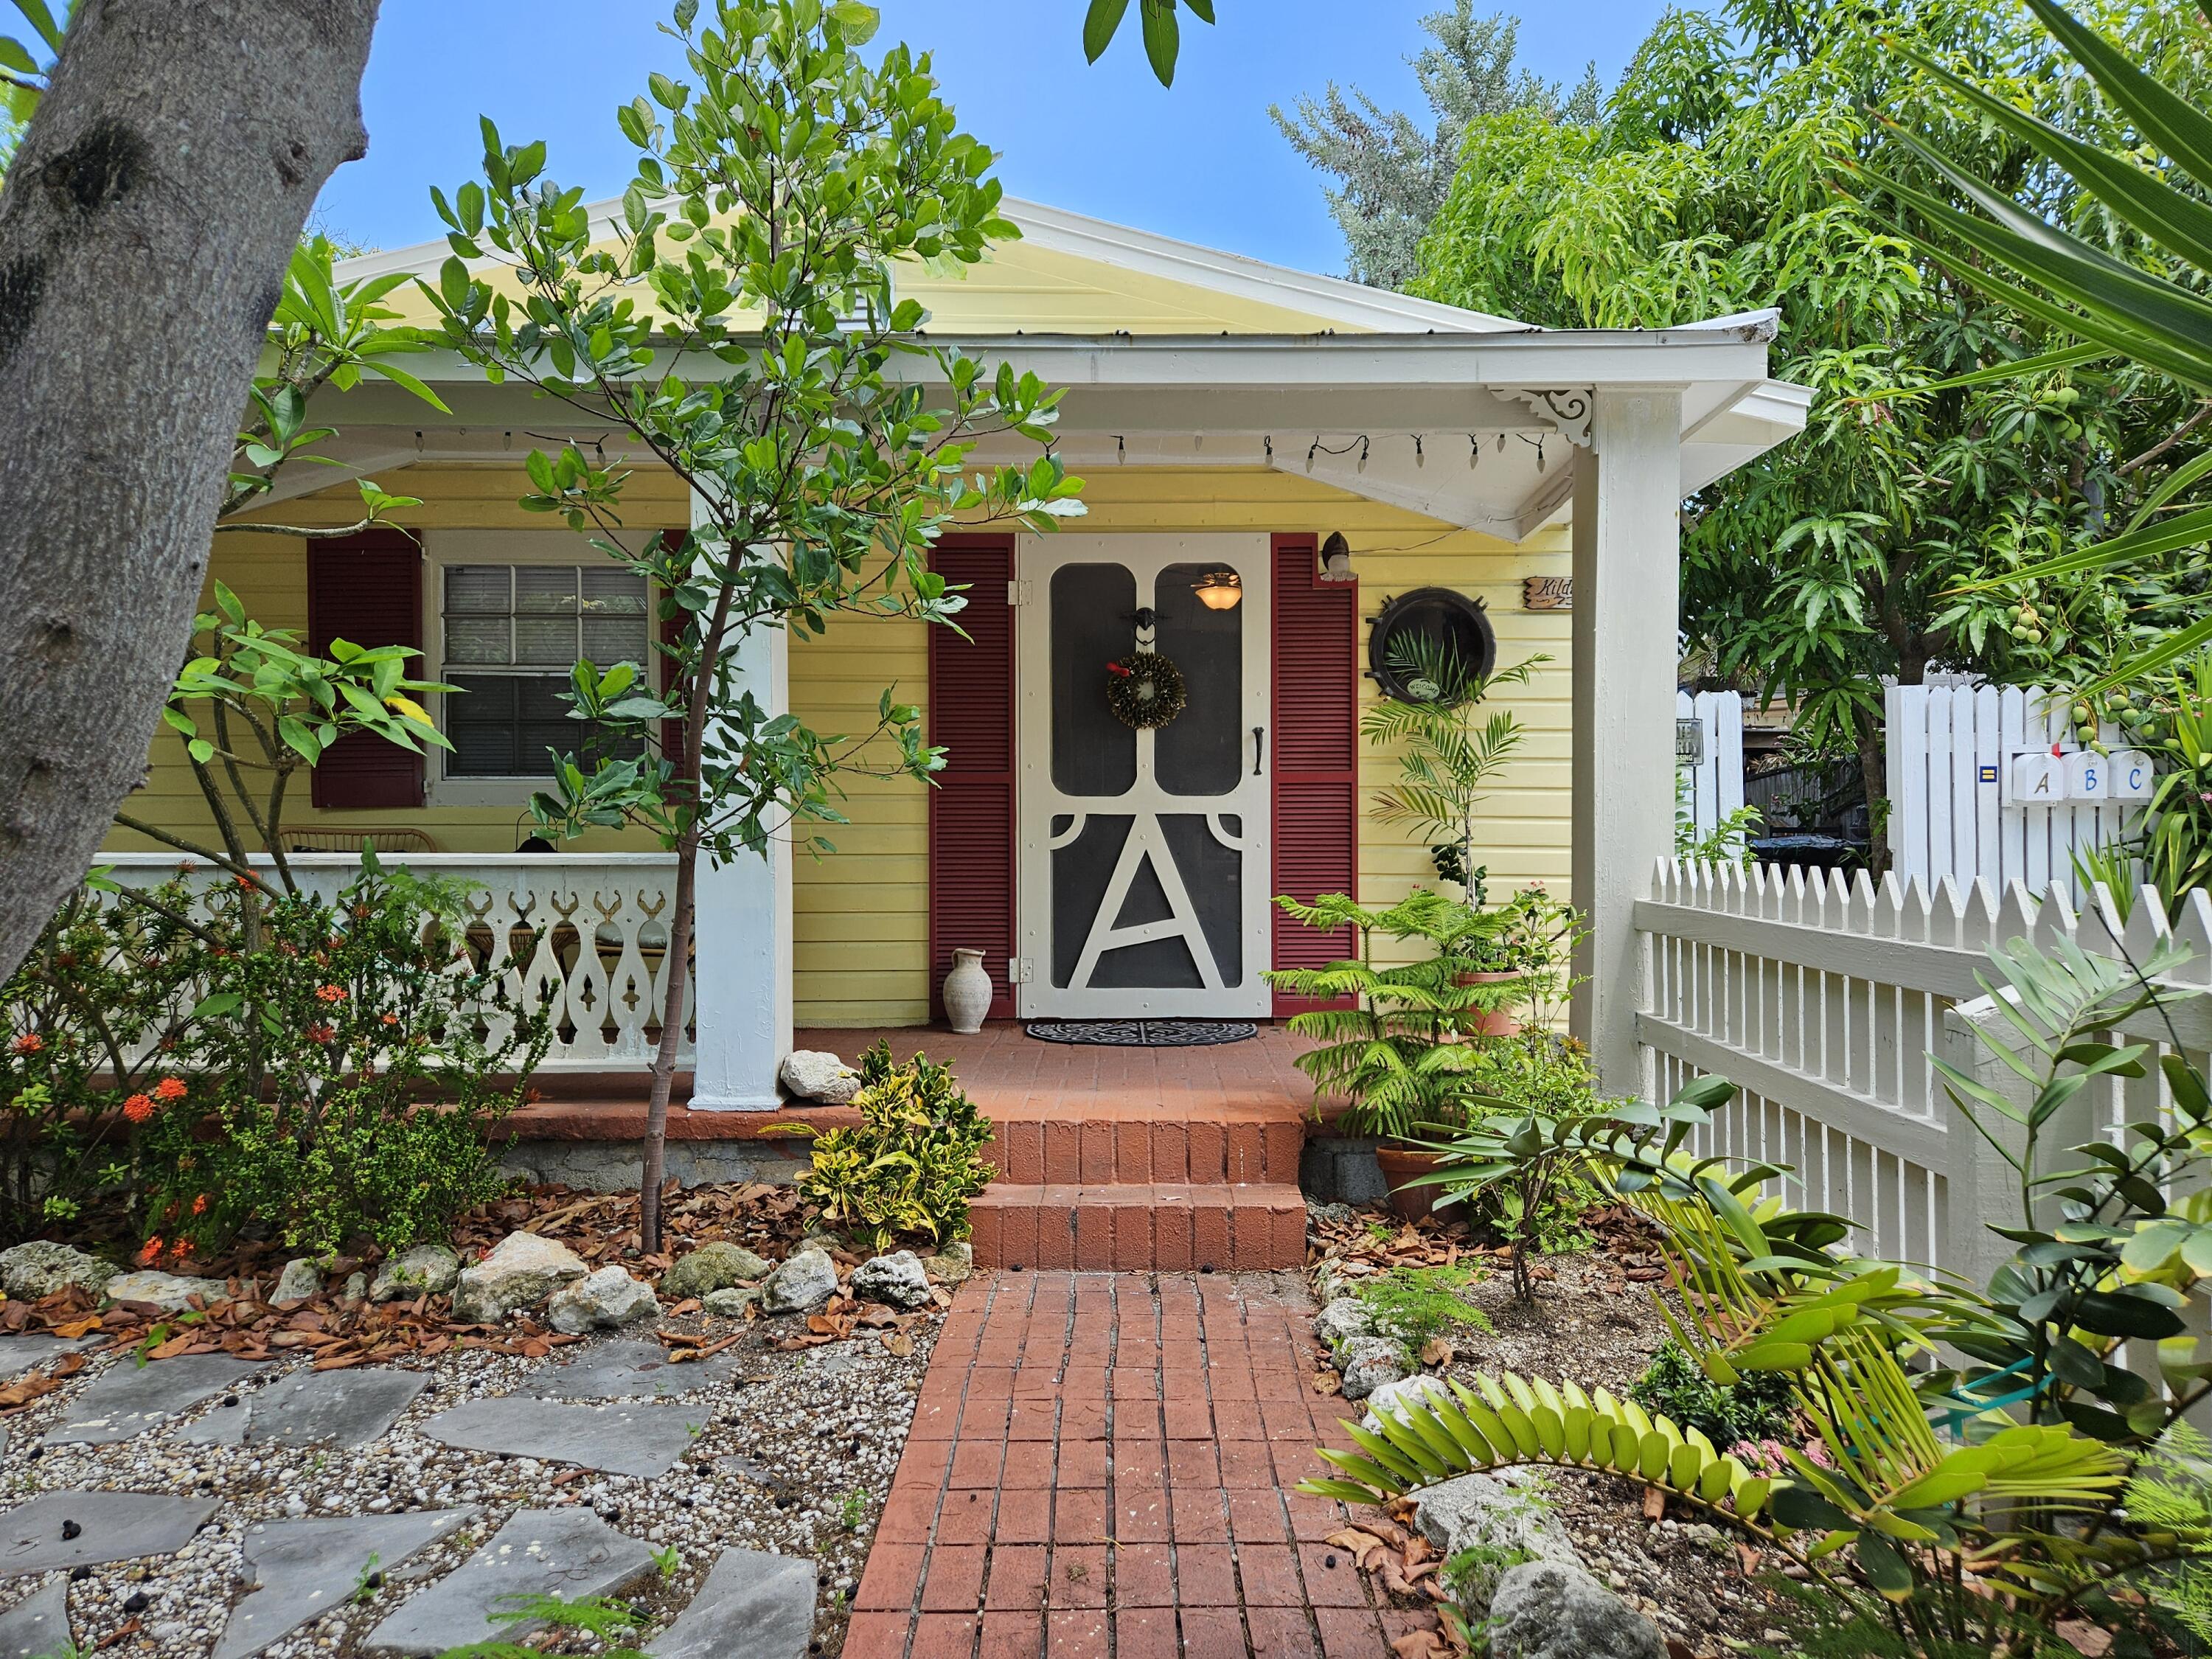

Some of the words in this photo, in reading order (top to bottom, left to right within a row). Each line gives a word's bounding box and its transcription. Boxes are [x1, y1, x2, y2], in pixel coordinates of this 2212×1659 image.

[2034, 772, 2049, 794] A
[2084, 768, 2097, 791] B
[2129, 768, 2142, 790] C
